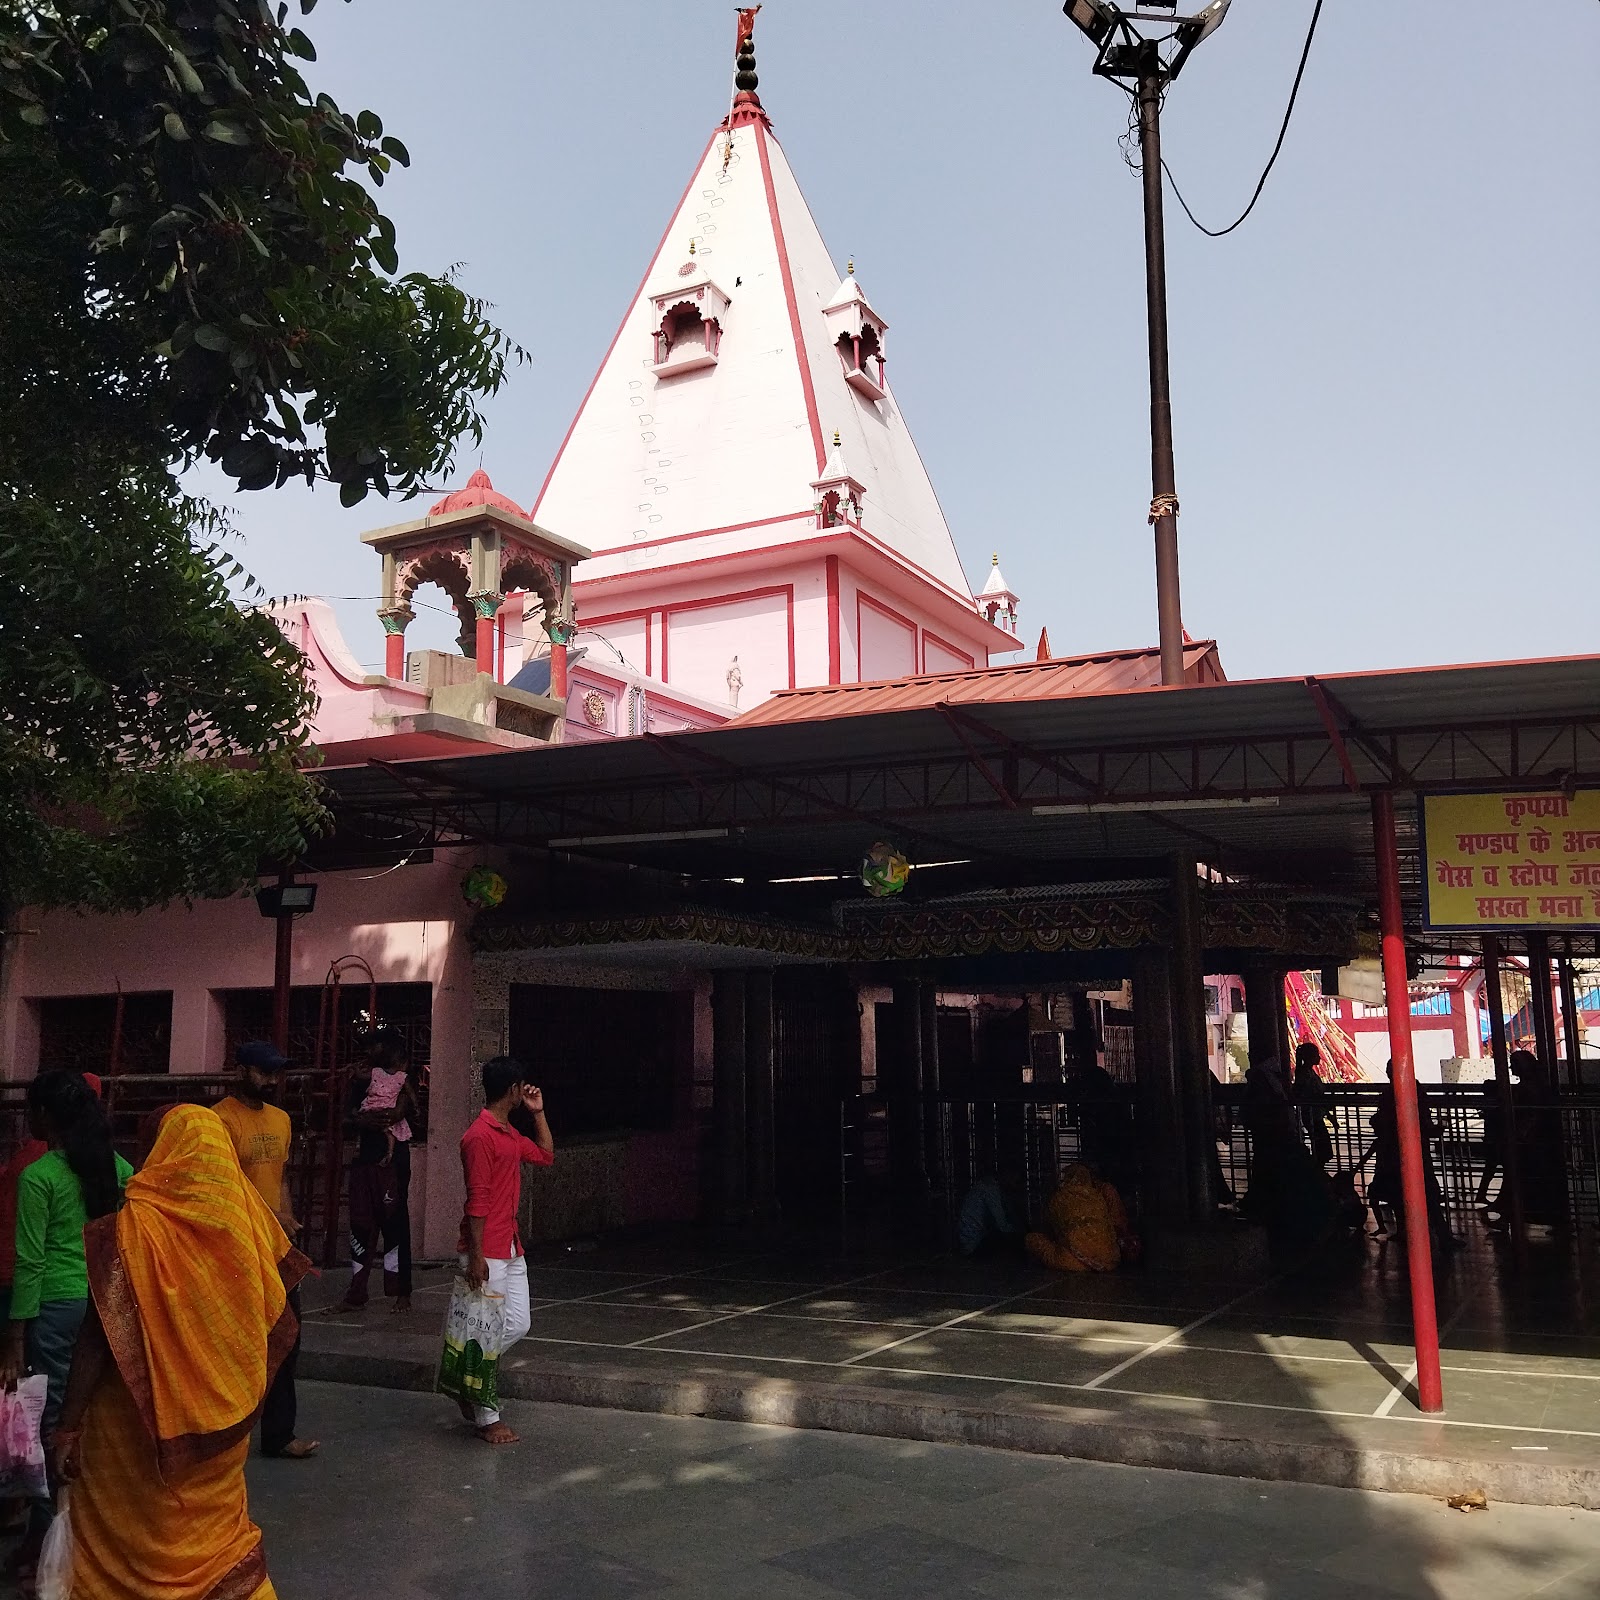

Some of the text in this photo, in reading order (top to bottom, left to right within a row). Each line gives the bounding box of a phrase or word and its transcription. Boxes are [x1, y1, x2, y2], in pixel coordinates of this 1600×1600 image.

[1502, 795, 1569, 827] कृपया
[1455, 832, 1520, 855] मण्डप
[1526, 825, 1552, 853] के
[1435, 860, 1474, 888] गैस
[1481, 865, 1500, 887] व
[1475, 896, 1530, 918] सख्त
[1537, 896, 1584, 918] मना
